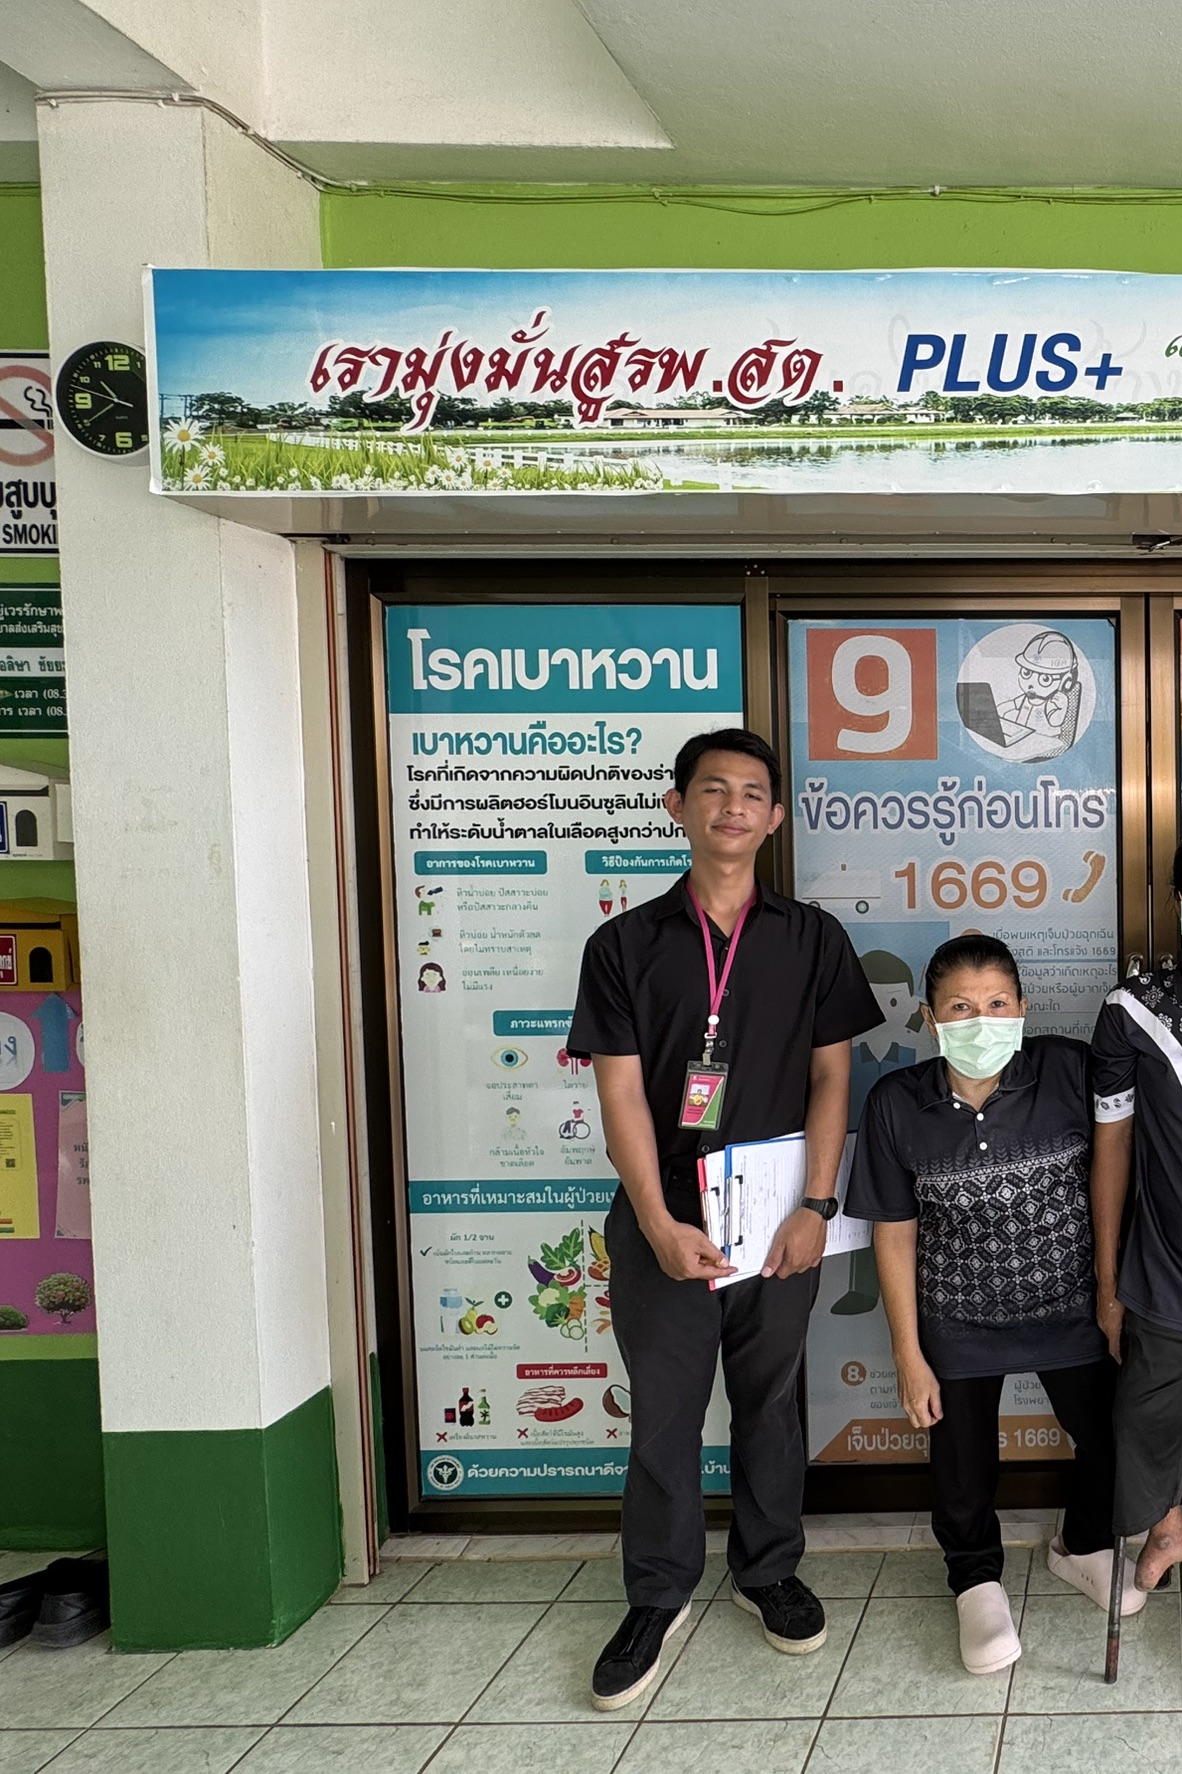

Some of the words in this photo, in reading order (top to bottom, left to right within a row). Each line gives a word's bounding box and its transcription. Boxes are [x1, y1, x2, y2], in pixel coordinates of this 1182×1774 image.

[104, 354, 130, 371] 12
[896, 332, 1123, 393] PLUS+
[75, 393, 92, 410] 9
[115, 432, 132, 448] 6
[3, 524, 58, 545] SMOKI
[407, 628, 718, 691] โรคเบาหวาน
[832, 634, 913, 754] 9
[412, 720, 643, 756] เบาหวานคืออะไร?
[407, 760, 675, 782] โรคที่เกิดจากความผิดปกติของร่า
[801, 780, 1106, 846] ข้อควรรู้ก่อนโทร
[410, 817, 687, 845] ทำให้ระดับน้ำตาลในเลือดสูงกว่าปก
[426, 857, 536, 869] อาการของโรคเบาหวาน
[602, 854, 692, 868] วิธีป้องกันการเกิดโร
[895, 860, 1048, 909] 1669
[1091, 947, 1116, 956] 1669
[510, 1016, 573, 1030] ภาวะแทรกซ้
[869, 1369, 897, 1379] ช่วยเห
[848, 1425, 929, 1457] เจ็บป่วยฉุ
[1014, 1429, 1061, 1448] 1669
